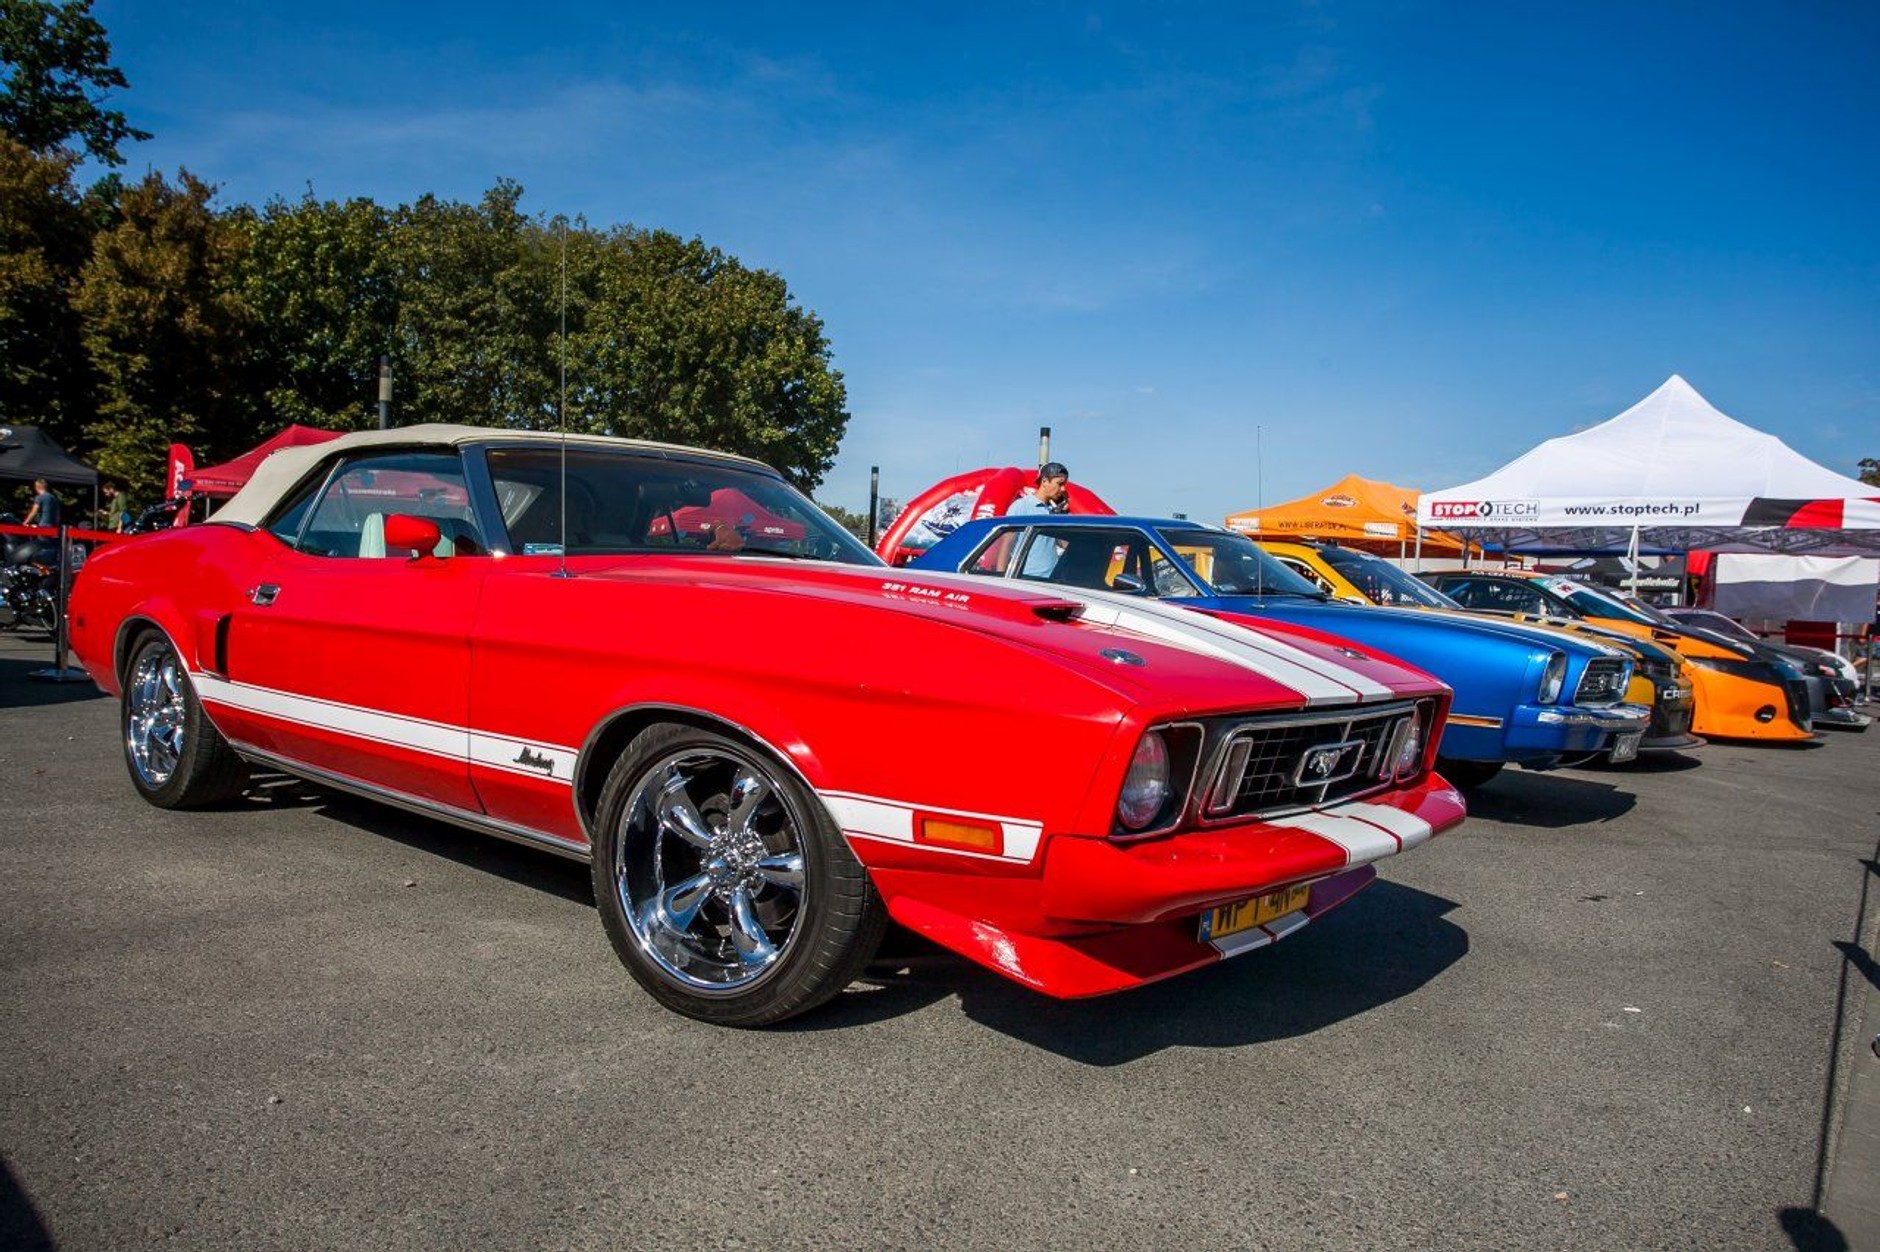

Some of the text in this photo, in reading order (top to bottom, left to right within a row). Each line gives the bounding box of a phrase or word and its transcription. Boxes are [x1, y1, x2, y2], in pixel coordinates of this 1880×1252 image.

[1434, 503, 1538, 516] STOP TECH
[1564, 502, 1700, 517] www.stoptech.pl
[908, 586, 942, 598] RAM
[943, 592, 970, 603] AIR
